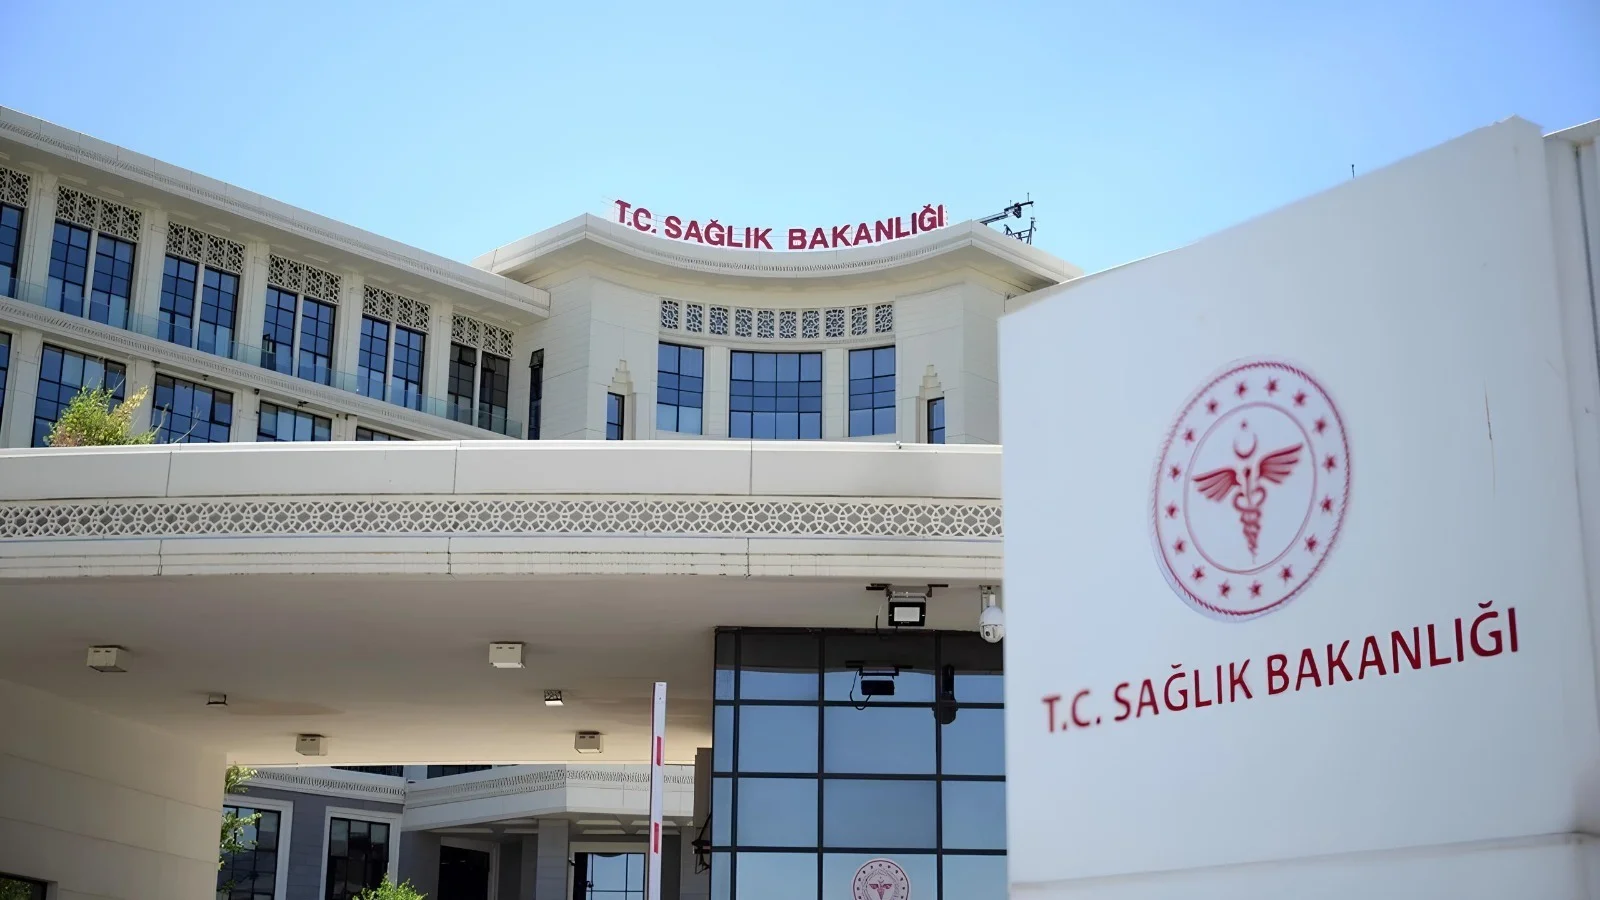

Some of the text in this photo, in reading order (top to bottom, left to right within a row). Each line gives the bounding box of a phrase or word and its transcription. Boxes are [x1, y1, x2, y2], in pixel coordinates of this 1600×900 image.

[615, 199, 945, 250] T.C. SAĞLIK BAKANLIĞI
[1042, 601, 1519, 732] T.C. SAĞLIK BAKANLIĞI
